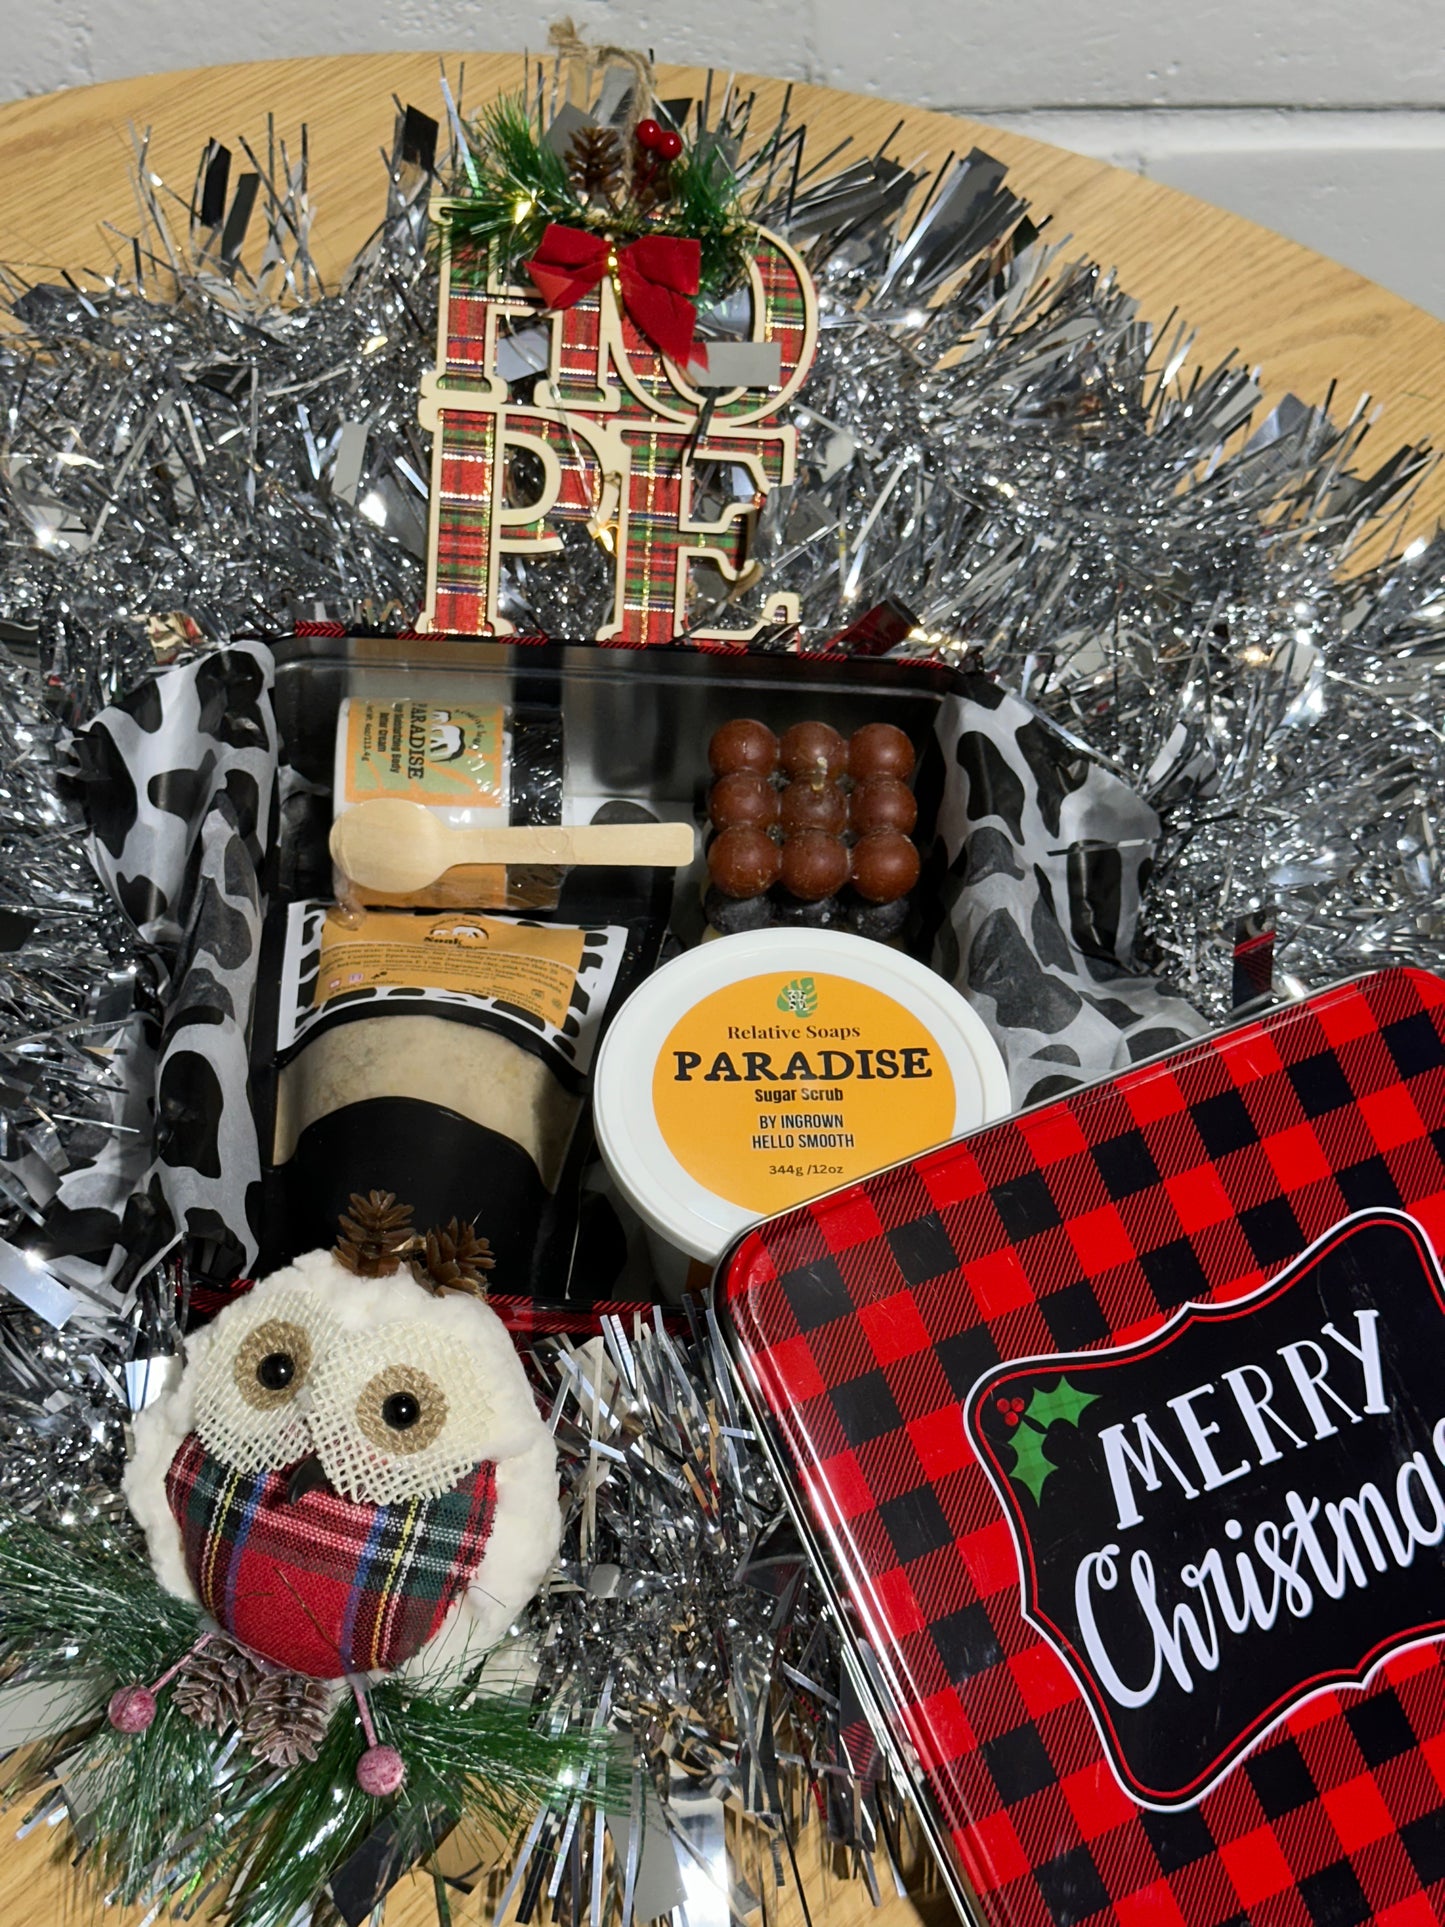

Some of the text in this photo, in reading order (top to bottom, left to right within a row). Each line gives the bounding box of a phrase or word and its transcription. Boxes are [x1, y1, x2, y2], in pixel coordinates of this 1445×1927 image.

[390, 754, 402, 773] Body
[729, 1026, 860, 1040] Relative Soaps
[673, 1048, 932, 1081] PARADISE
[755, 1088, 843, 1103] Sugar Scrub
[760, 1115, 843, 1129] BY INGROWN
[753, 1134, 854, 1148] HELLO SMOOTH
[770, 1165, 842, 1176] 344g /12oz
[1098, 1309, 1390, 1530] MERRY
